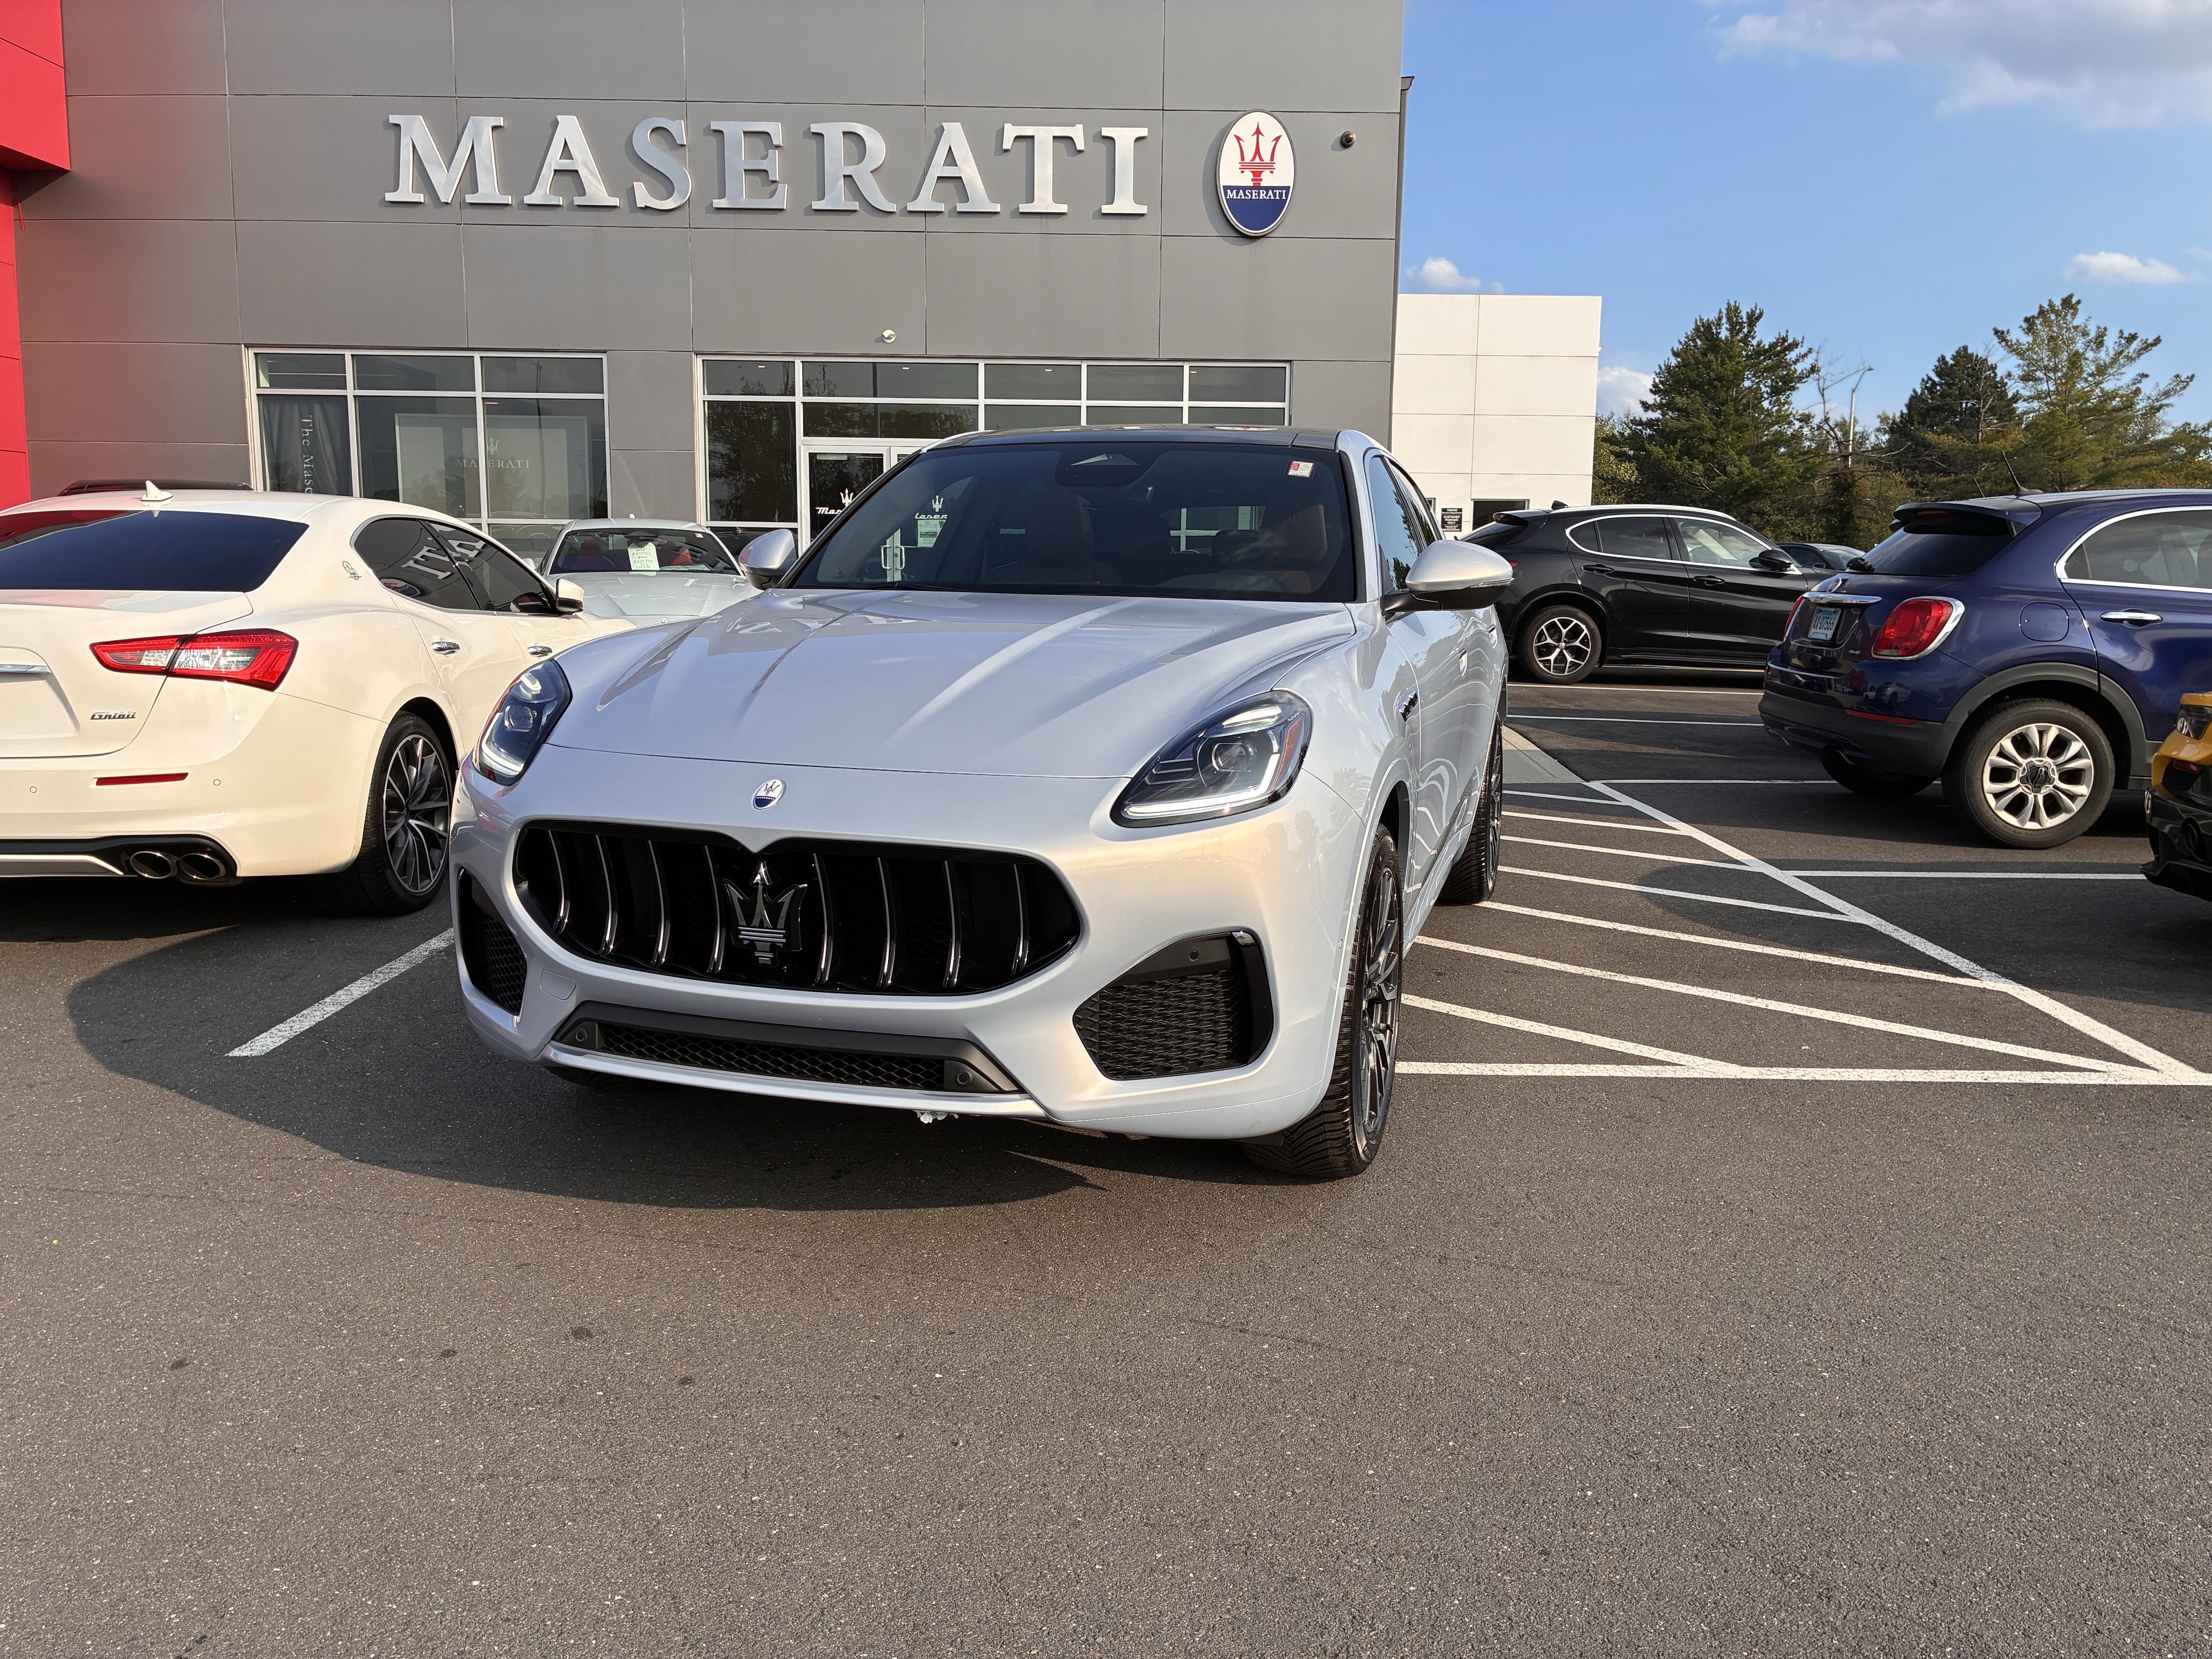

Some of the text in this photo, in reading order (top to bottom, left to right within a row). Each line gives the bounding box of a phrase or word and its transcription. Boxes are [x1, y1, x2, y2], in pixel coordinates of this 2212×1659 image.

[385, 114, 1149, 215] MASERATI
[1226, 189, 1286, 199] MASERATI
[301, 415, 313, 446] The
[456, 459, 530, 468] MAERATI
[90, 711, 137, 720] Ghibli
